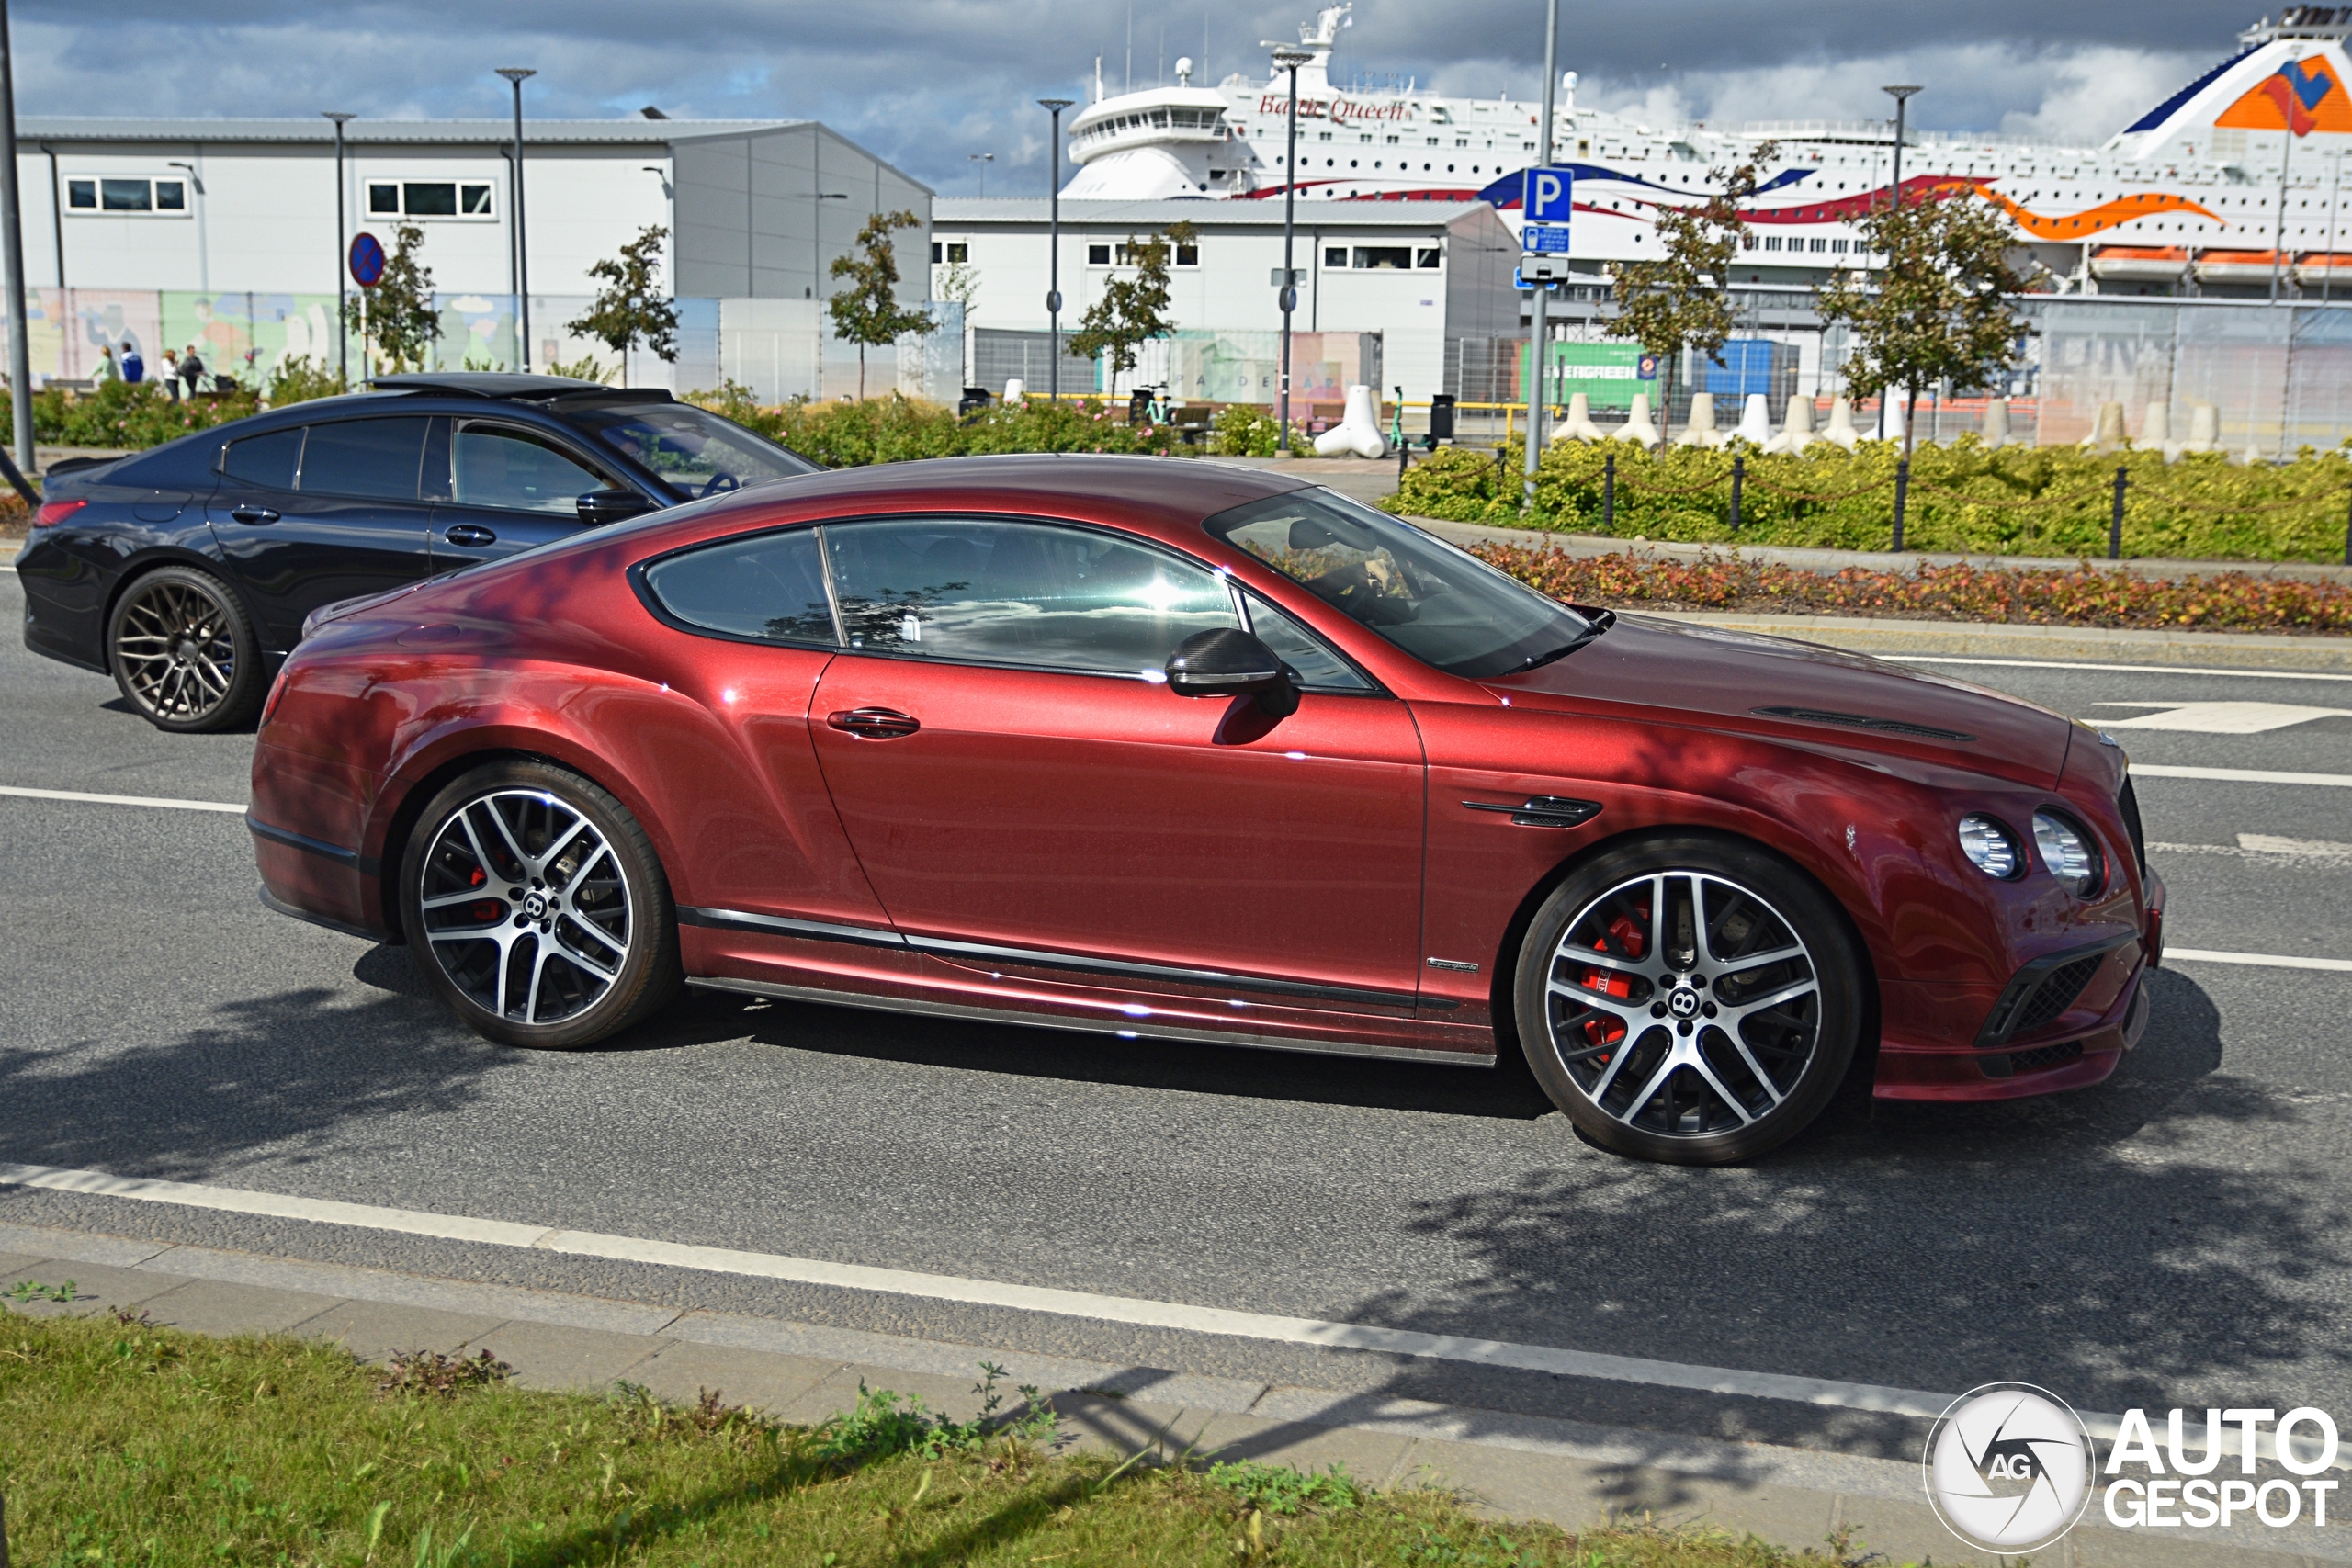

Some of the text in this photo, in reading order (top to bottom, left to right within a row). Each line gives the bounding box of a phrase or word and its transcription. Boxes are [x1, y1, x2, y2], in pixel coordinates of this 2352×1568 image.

[1259, 95, 1407, 124] Batic Queen
[1535, 175, 1562, 216] P
[1428, 960, 1477, 970] Supersports
